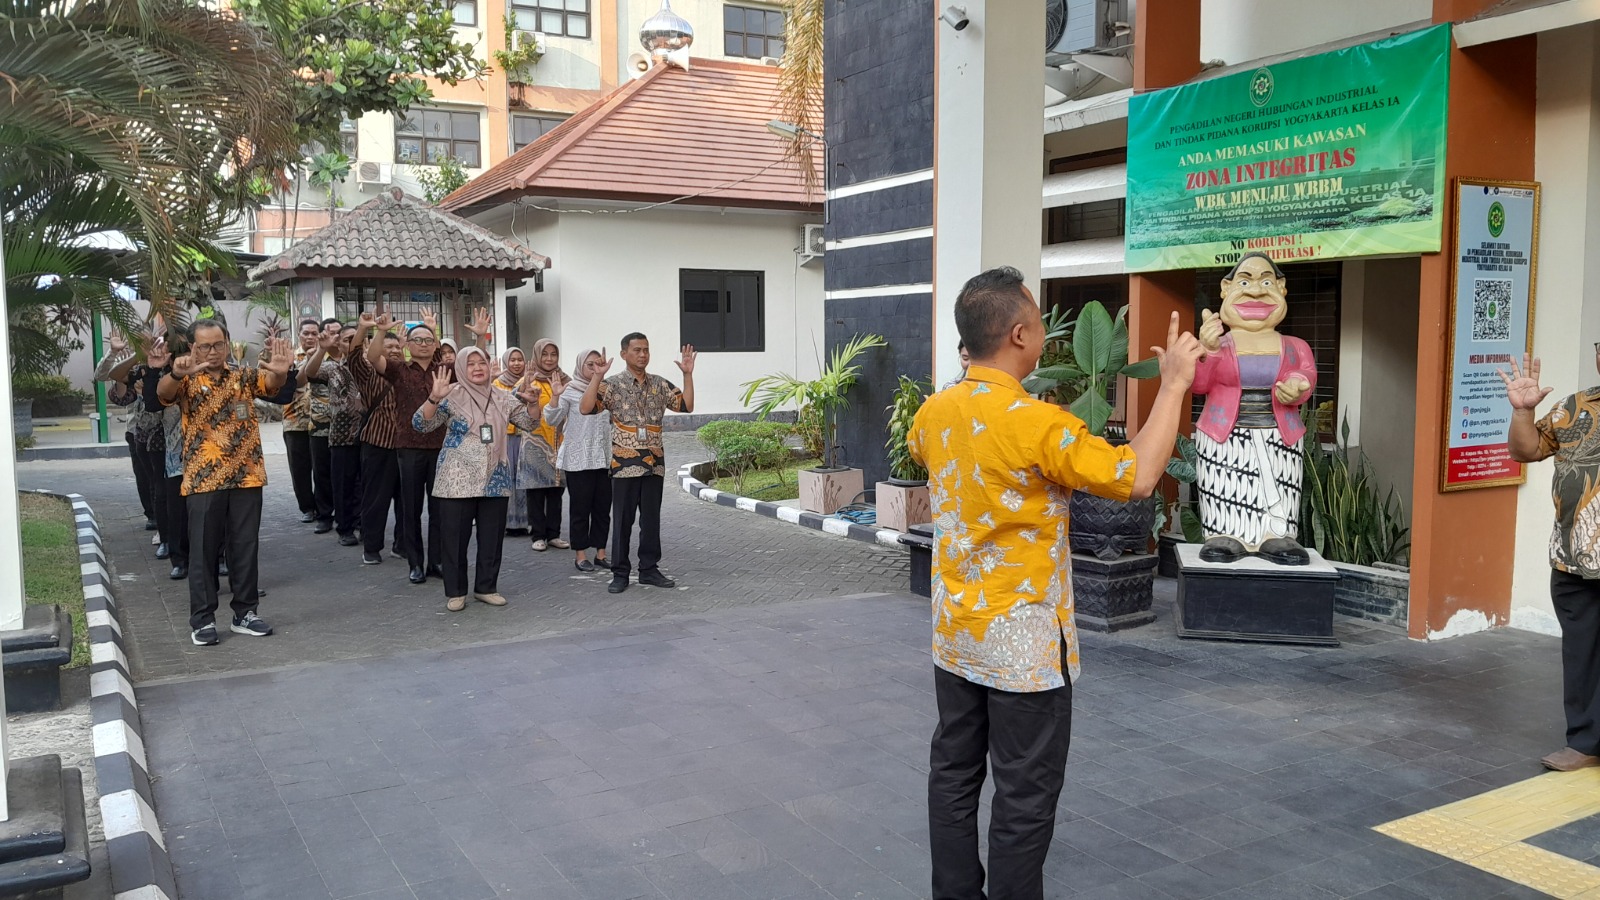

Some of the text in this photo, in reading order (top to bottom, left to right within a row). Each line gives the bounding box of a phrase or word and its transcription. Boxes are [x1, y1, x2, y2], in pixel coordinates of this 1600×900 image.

[1155, 140, 1171, 150] DAN
[1174, 134, 1205, 146] TINDAK
[1207, 127, 1239, 142] PIDANA
[1242, 119, 1281, 134] KORUPSI
[1284, 105, 1349, 126] YOGYAKARTA
[1351, 99, 1385, 113] KELAS
[1170, 85, 1378, 134] PENGADILAN NEGERI HUBUNGAN INDUSTRIAL
[1178, 123, 1367, 167] ANDA MEMASUKI KAWASAN
[1186, 148, 1356, 190] ZONA INTEGRITAS
[1195, 176, 1343, 209] WBK MENUJU WBBM
[1311, 180, 1412, 198] INDUSTRIAL
[1159, 215, 1187, 223] TINDAK
[1189, 211, 1220, 221] PIDANA
[1222, 206, 1264, 217] KORUPSI
[1266, 196, 1347, 213] YOGYAKARTA
[1351, 190, 1402, 204] KELAS
[1292, 207, 1350, 216] YOGYAKARTA
[1214, 253, 1241, 264] STOP
[1230, 239, 1245, 250] NO
[1247, 235, 1296, 249] KORUPSI
[1469, 354, 1510, 364] MEDIA INFORMASI
